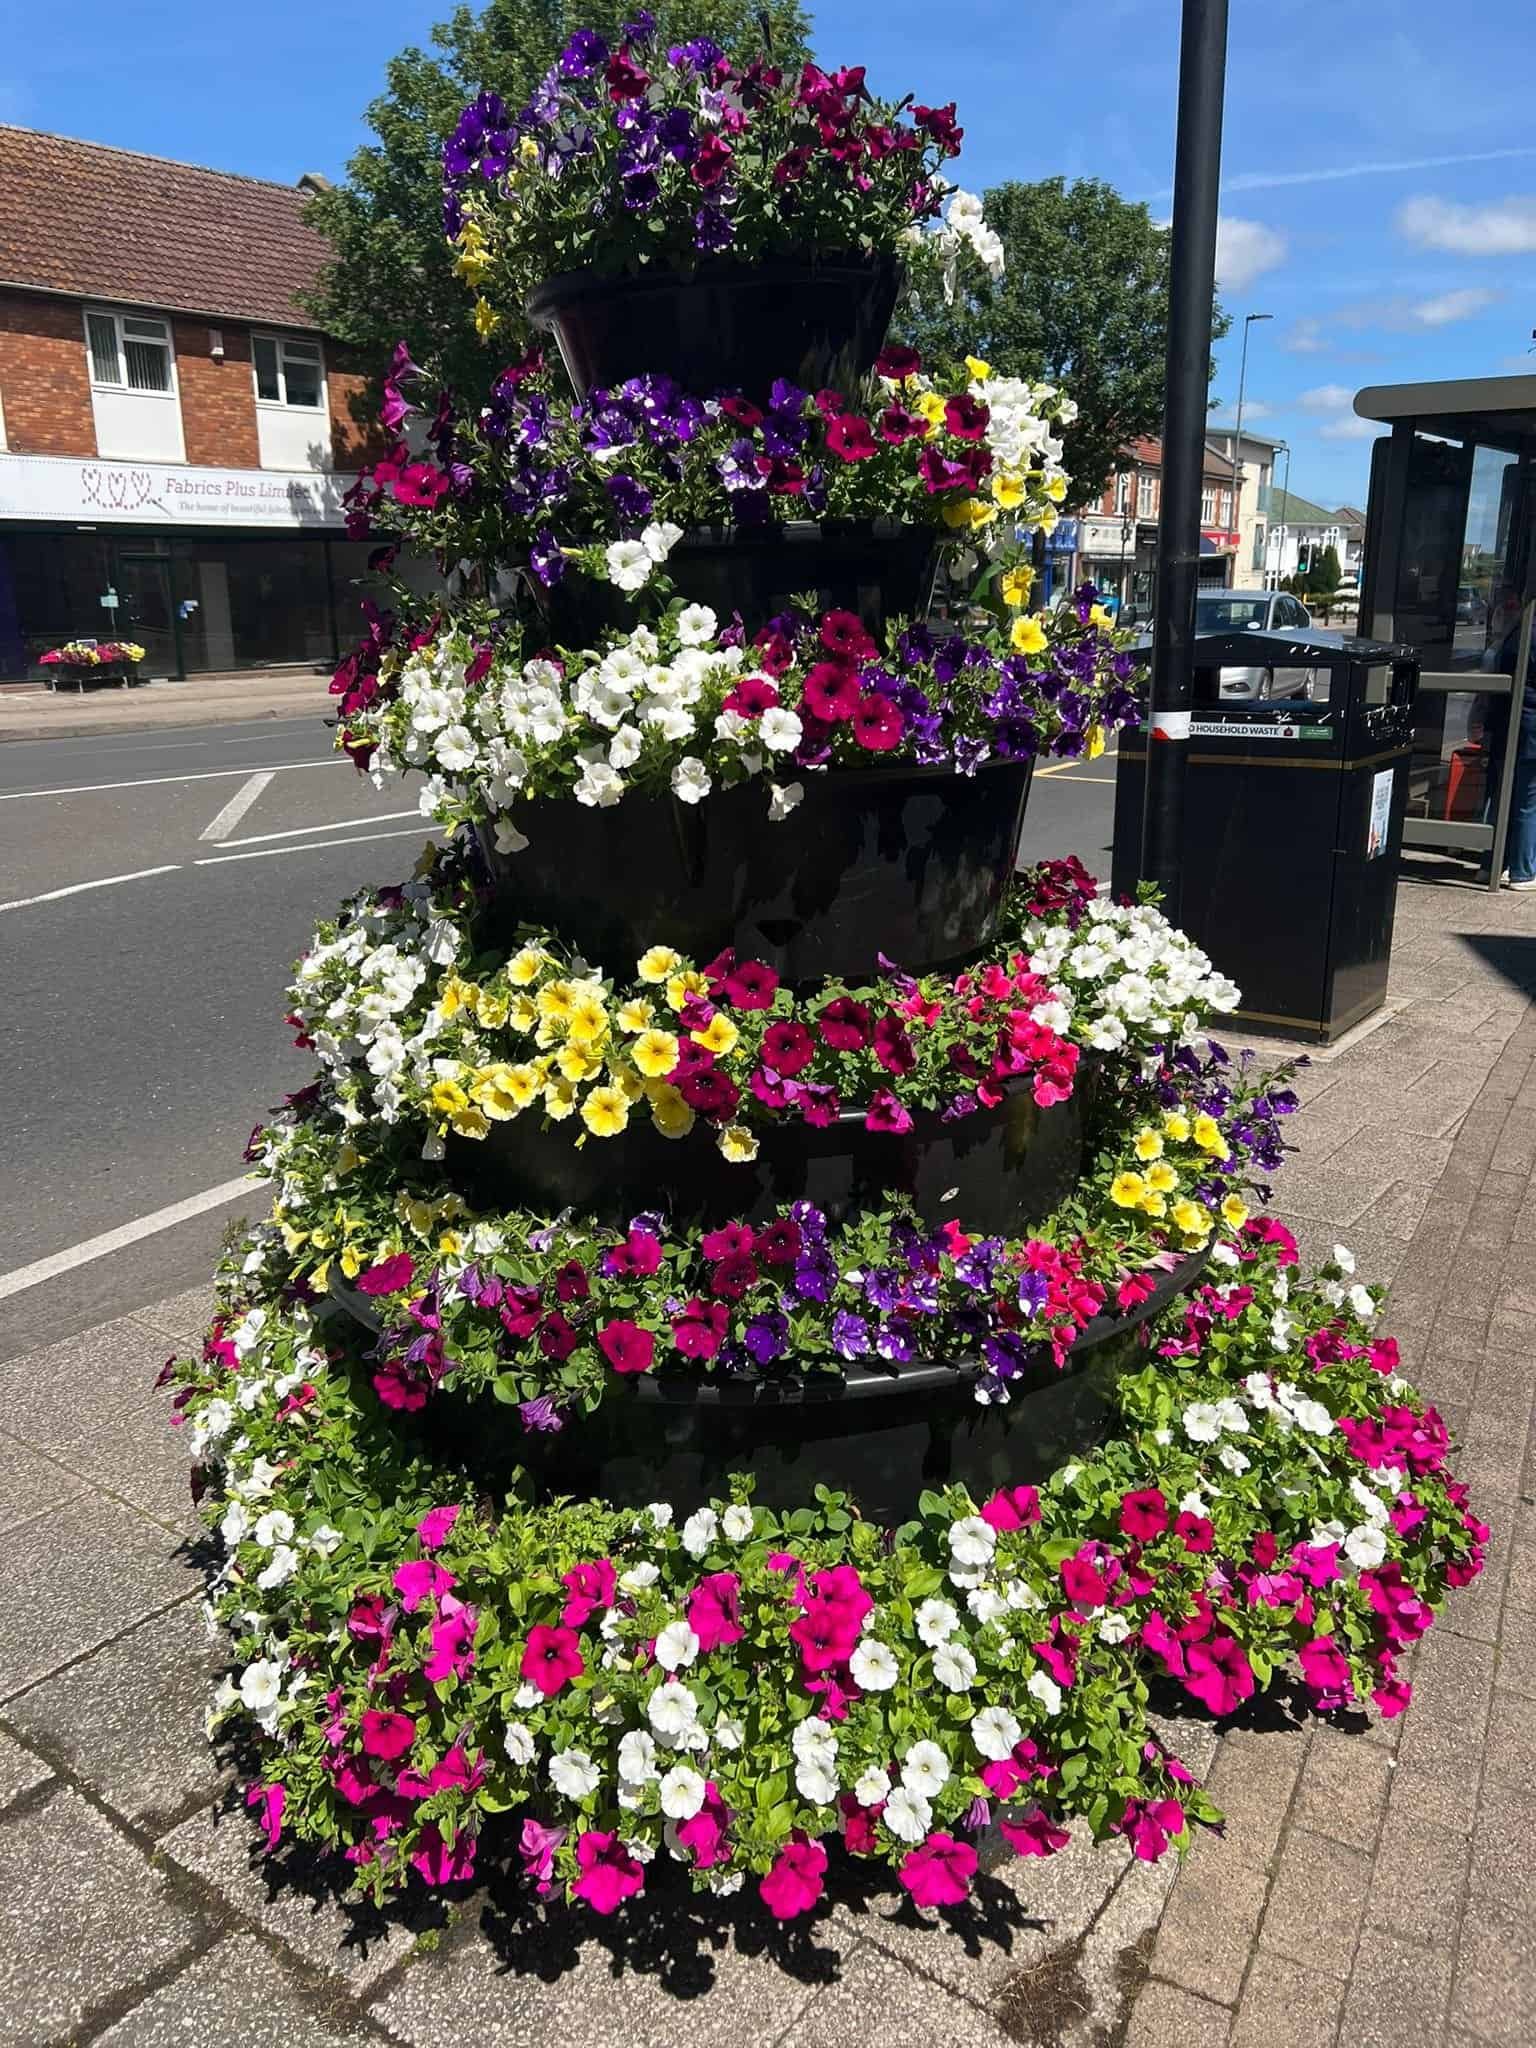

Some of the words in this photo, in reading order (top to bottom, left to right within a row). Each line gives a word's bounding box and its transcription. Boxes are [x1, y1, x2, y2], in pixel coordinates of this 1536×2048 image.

[165, 478, 222, 496] Fabrics
[225, 481, 256, 497] Plus
[179, 501, 194, 511] The
[1196, 724, 1248, 734] HOUSEHOLD
[1250, 727, 1279, 736] WASTE
